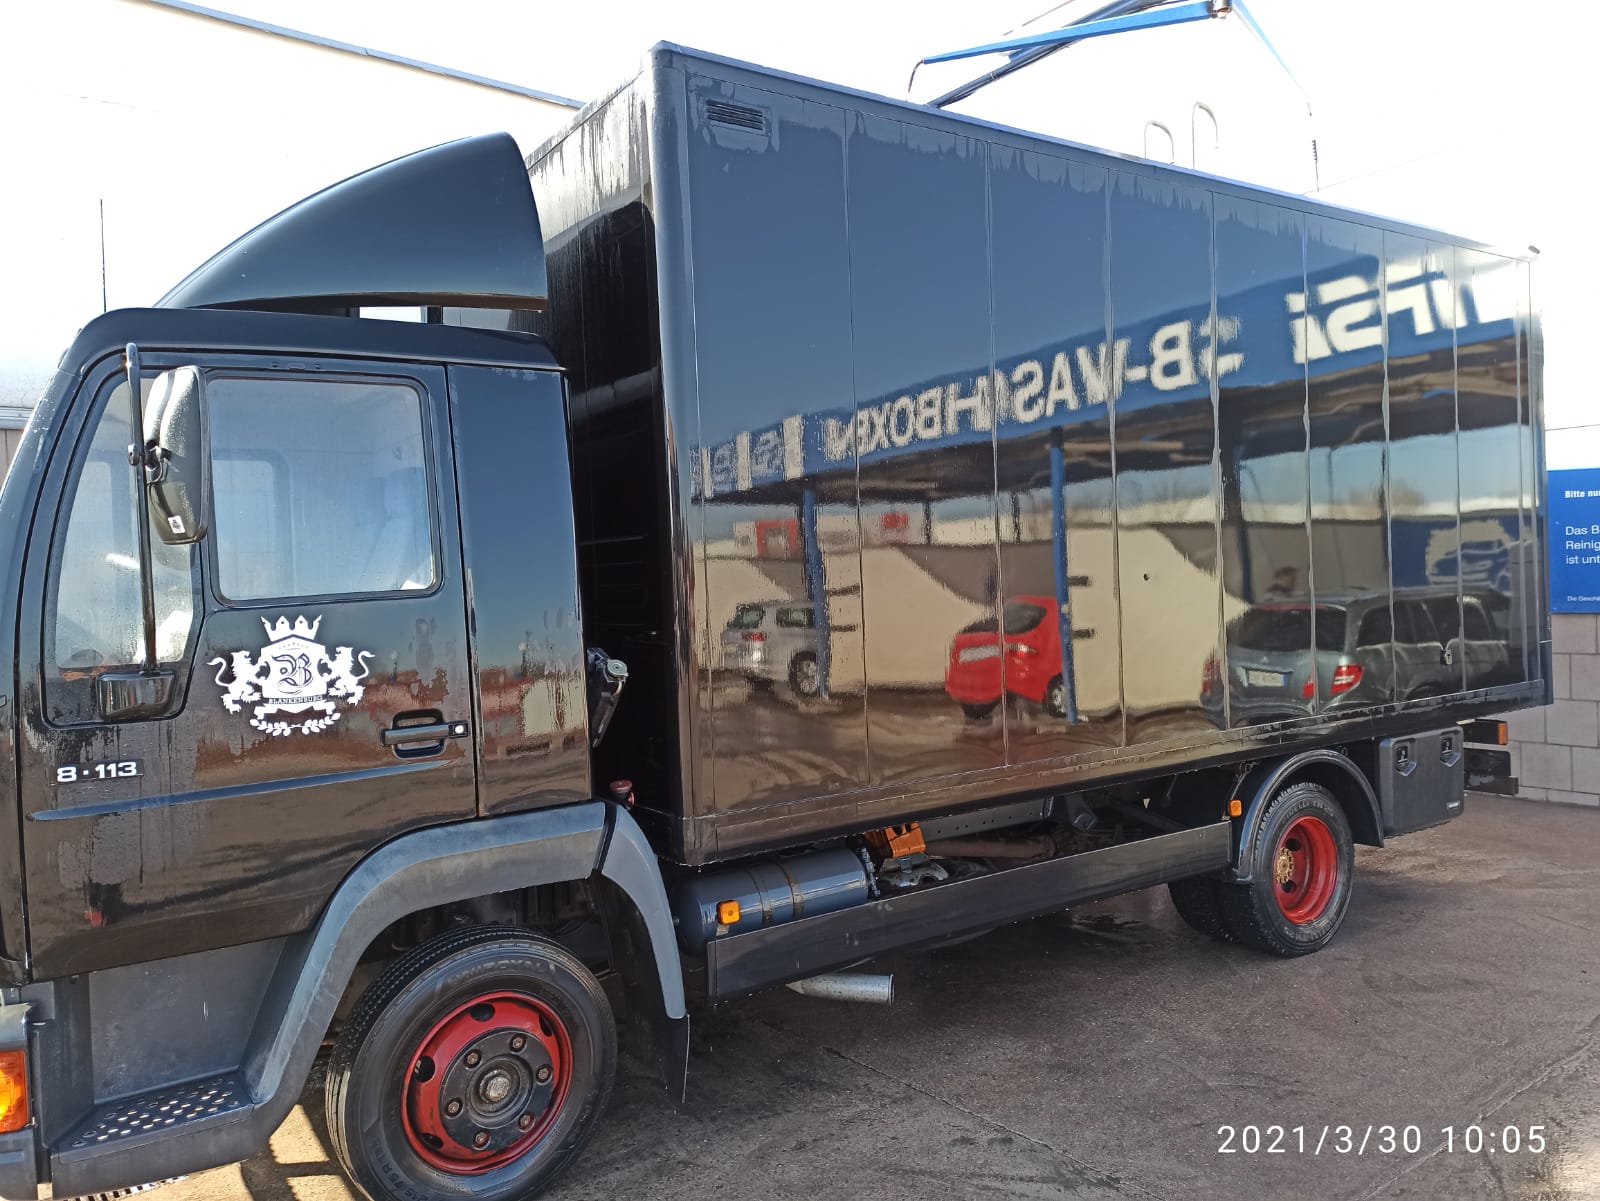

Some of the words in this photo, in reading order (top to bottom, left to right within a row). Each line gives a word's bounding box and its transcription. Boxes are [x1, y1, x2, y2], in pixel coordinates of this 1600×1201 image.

[1565, 490, 1585, 498] Bitte
[1565, 526, 1588, 536] Das
[1591, 524, 1600, 534] B
[1566, 555, 1579, 565] ist
